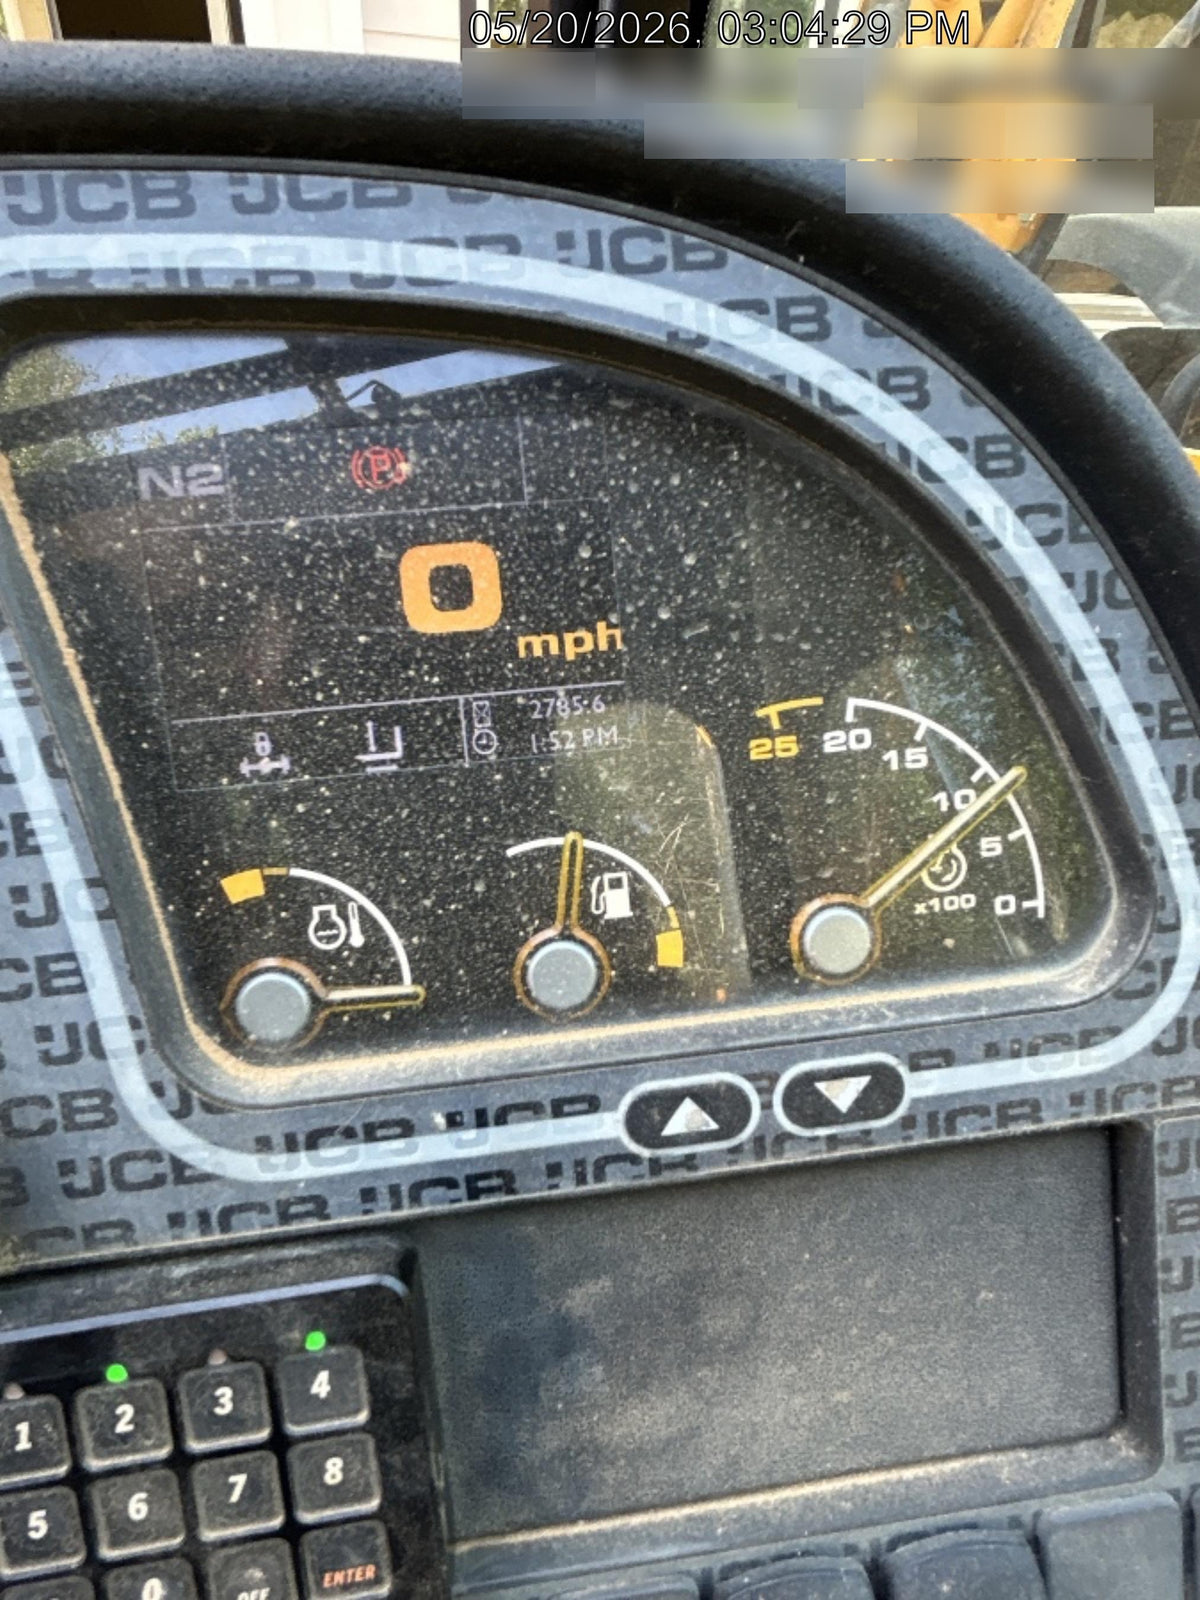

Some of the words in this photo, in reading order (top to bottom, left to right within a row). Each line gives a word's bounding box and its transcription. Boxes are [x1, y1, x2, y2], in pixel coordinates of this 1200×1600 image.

[3, 173, 197, 226] JCB
[138, 463, 225, 501] N2
[400, 541, 503, 634] 0
[518, 621, 622, 660] mph
[583, 725, 618, 746] PM
[750, 735, 799, 760] 25
[823, 728, 872, 752] 20
[883, 747, 928, 770] 15
[931, 789, 976, 811] 10
[980, 837, 1002, 857] 5
[914, 894, 976, 914] x100
[994, 895, 1016, 915] 0
[311, 1370, 331, 1398] 4
[213, 1387, 234, 1416] 3
[114, 1404, 135, 1433] 2
[15, 1422, 32, 1451] 1
[323, 1457, 344, 1485] 8
[228, 1473, 247, 1503] 7
[128, 1492, 148, 1521] 6
[28, 1510, 48, 1539] 5
[322, 1564, 377, 1588] ENTER
